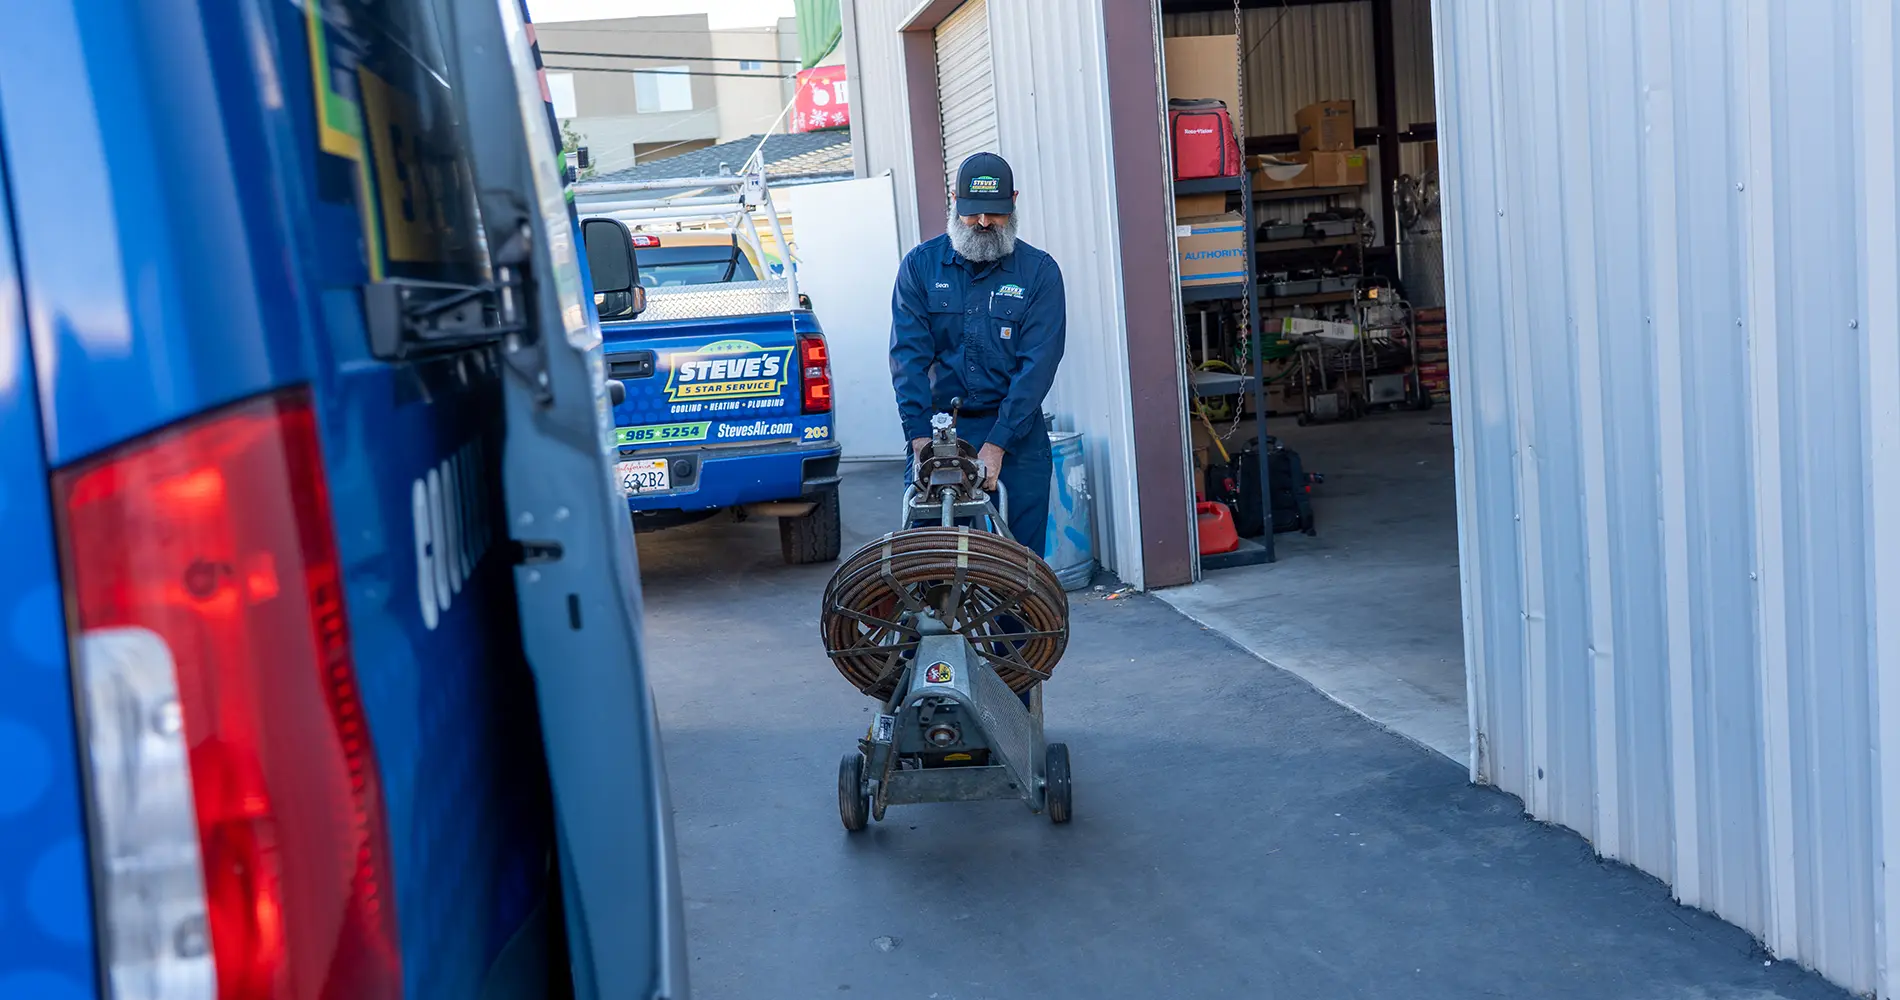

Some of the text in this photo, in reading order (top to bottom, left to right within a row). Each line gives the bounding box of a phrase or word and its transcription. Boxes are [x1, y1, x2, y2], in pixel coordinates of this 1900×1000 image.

[1185, 248, 1244, 260] AUTHORITY
[679, 354, 780, 381] STEVE'S
[685, 381, 771, 394] 5 STAR SERVICE
[671, 398, 785, 413] COOLING HEATING PLUMBING
[625, 426, 700, 441] 985 5254
[718, 421, 793, 437] StevesAir.com
[804, 425, 829, 439] 203
